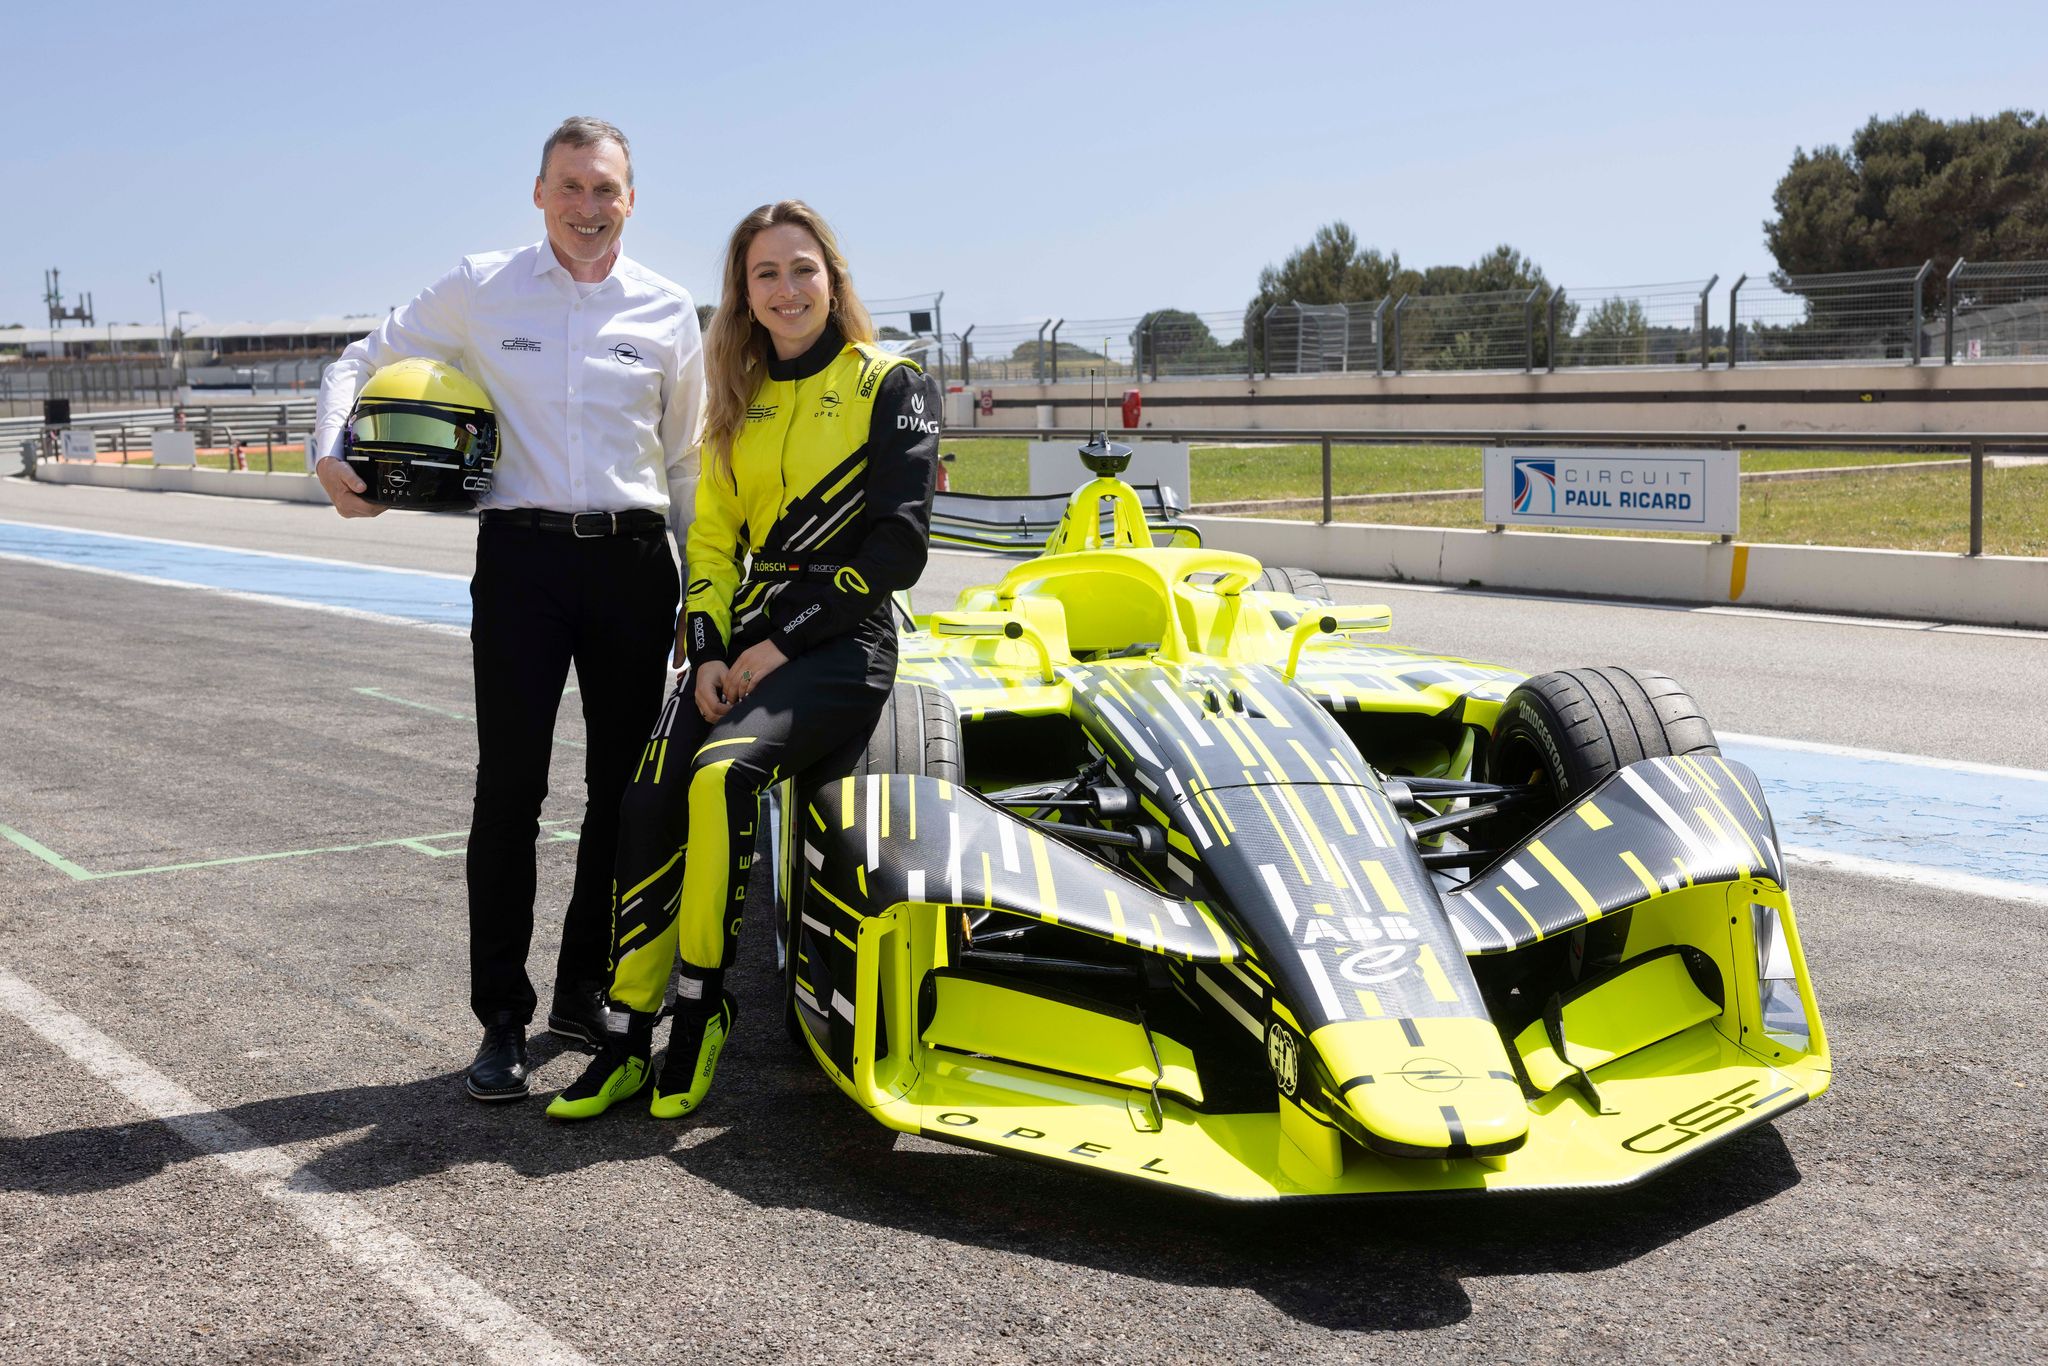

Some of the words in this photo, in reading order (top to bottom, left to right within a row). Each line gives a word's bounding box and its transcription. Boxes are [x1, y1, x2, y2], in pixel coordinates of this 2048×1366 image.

[860, 360, 889, 399] sparco
[897, 415, 939, 434] DVAG
[382, 488, 411, 496] OPEL
[1565, 469, 1691, 485] CIRCUIT
[1565, 490, 1612, 507] PAUL
[1620, 492, 1691, 510] RICARD
[783, 603, 822, 634] sparco
[1519, 700, 1569, 792] BRIDGESTONE
[730, 821, 753, 936] OPEL
[1304, 916, 1420, 944] ABB
[1621, 1079, 1793, 1154] GSE
[936, 1112, 1169, 1175] OPEL
